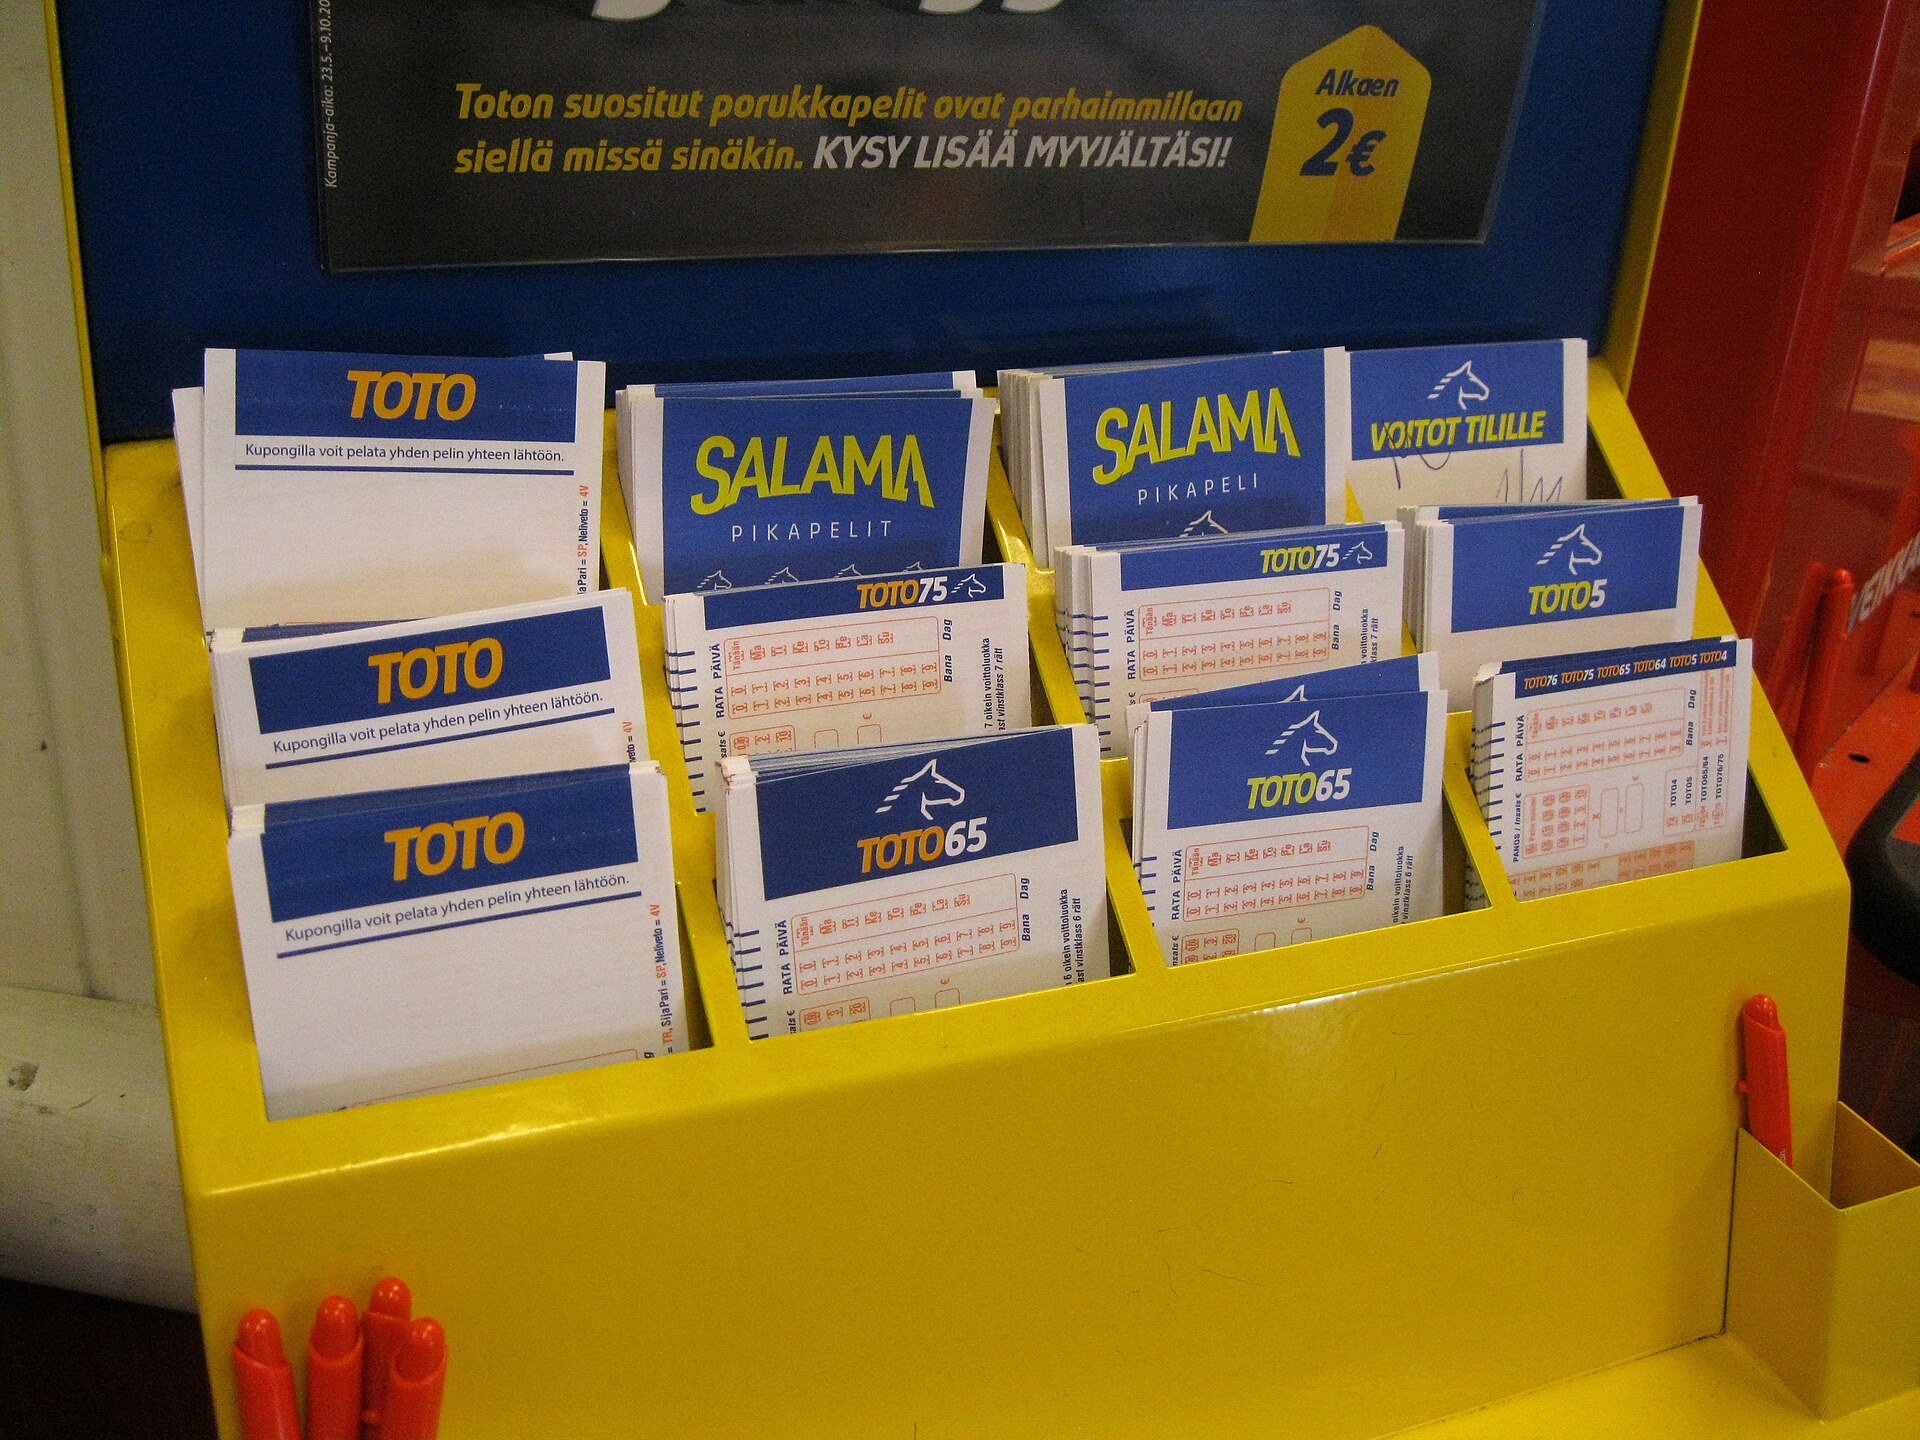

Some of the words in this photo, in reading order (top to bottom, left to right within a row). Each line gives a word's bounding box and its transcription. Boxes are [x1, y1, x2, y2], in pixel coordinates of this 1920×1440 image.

[1314, 67, 1400, 98] Alkaen
[454, 82, 554, 120] Toton
[562, 84, 702, 119] suositut
[707, 83, 925, 128] porukkapelit
[933, 89, 1001, 119] ovat
[1008, 86, 1243, 128] parhaimmillaan
[321, 85, 339, 189] Kampanja-aika:
[453, 138, 554, 174] siellä
[562, 136, 661, 173] missä
[670, 135, 804, 171] sinäkin.
[811, 136, 906, 170] KYSY
[912, 129, 1016, 170] LISÄÄ
[1022, 129, 1233, 169] MYYJÄLTÄSI!
[1299, 106, 1388, 178] 2€
[346, 368, 477, 422] TOTO
[1091, 387, 1302, 486] SALAMA
[1369, 416, 1464, 452] VOITOT
[1465, 409, 1548, 445] TILILLE
[245, 442, 317, 462] Kupongilla
[319, 444, 344, 458] voit
[346, 445, 388, 462] pelata
[389, 445, 430, 463] yhden
[432, 447, 465, 464] pelin
[467, 448, 511, 465] yhteen
[513, 448, 565, 463] lähtöön.
[579, 485, 589, 497] 4V
[690, 433, 935, 516] SALAMA
[1137, 474, 1259, 507] PIKAPELI
[578, 508, 588, 542] Neliveto
[731, 520, 893, 543] PIKAPELIT
[1260, 543, 1341, 575] TOTO75
[856, 575, 949, 610] TOTO75
[1332, 590, 1342, 611] Dag
[1528, 578, 1608, 616] TOTO5
[942, 618, 953, 641] Dag
[1126, 608, 1136, 644] PÄIVÄ
[1332, 624, 1341, 650] Bana
[367, 636, 504, 705] TOTO
[711, 642, 723, 680] PÄIVÄ
[943, 654, 953, 683] Bana
[981, 637, 992, 692] voittoluokka
[994, 648, 1004, 663] rätt
[1127, 649, 1137, 680] RATA
[1524, 675, 1558, 690] TOTO76
[1561, 669, 1594, 684] TOTO75
[1598, 663, 1631, 679] TOTO65
[1634, 658, 1667, 673] TOTO64
[1670, 653, 1698, 667] TOTO5
[1699, 649, 1727, 664] TOTO4
[714, 686, 725, 719] RATA
[983, 693, 993, 720] oikein
[995, 674, 1006, 717] vinstklass
[1687, 689, 1697, 709] Dag
[272, 730, 347, 756] Kupongilla
[349, 726, 376, 744] voit
[378, 719, 420, 741] pelata
[423, 714, 466, 736] yhden
[468, 707, 501, 729] pelin
[503, 700, 549, 722] yhteen
[550, 691, 604, 710] lähtöön.
[718, 730, 727, 738] €
[1516, 714, 1525, 747] PÄIVÄ
[1686, 721, 1694, 746] Bana
[1515, 753, 1524, 782] RATA
[1700, 756, 1709, 802] TOTO65/64
[1715, 753, 1724, 799] TOTO76/75
[1246, 767, 1353, 810] TOTO65
[1669, 778, 1678, 807] TOTO4
[1685, 776, 1693, 804] TOTO5
[383, 811, 526, 882] TOTO
[857, 816, 988, 875] TOTO65
[1369, 831, 1380, 852] Dag
[1512, 834, 1520, 863] PANOS
[1172, 849, 1183, 884] PÄIVÄ
[1366, 864, 1375, 892] Bana
[1018, 877, 1030, 900] Dag
[1171, 889, 1181, 921] RATA
[284, 916, 362, 943] Kupongilla
[364, 911, 393, 928] voit
[395, 904, 438, 926] pelata
[441, 896, 485, 918] yhden
[487, 889, 522, 910] pelin
[524, 882, 572, 902] yhteen
[573, 870, 630, 892] lähtöön.
[649, 903, 661, 917] 4V
[1058, 888, 1070, 944] voittoluokka
[774, 919, 789, 957] PÄIVÄ
[1021, 912, 1031, 943] Bana
[652, 927, 666, 964] Neliveto
[1062, 944, 1072, 972] oikein
[782, 962, 793, 995] RATA
